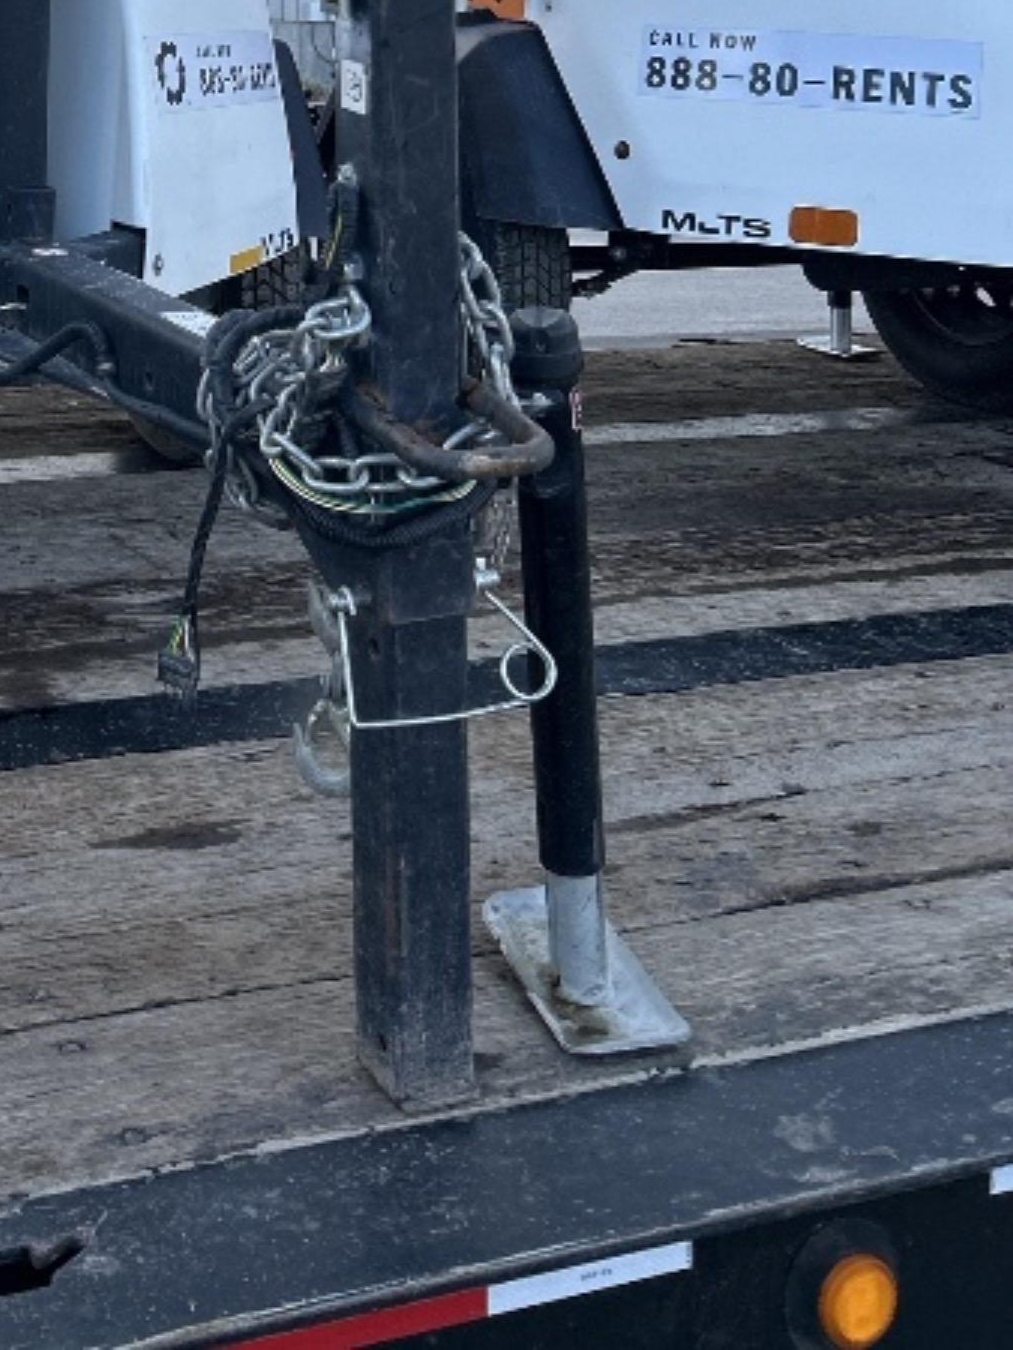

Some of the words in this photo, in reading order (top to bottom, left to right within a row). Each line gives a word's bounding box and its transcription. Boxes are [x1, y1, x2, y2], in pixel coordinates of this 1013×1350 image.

[649, 30, 699, 49] CALL
[709, 32, 757, 51] NOW
[645, 56, 974, 109] 888-80-RENTS
